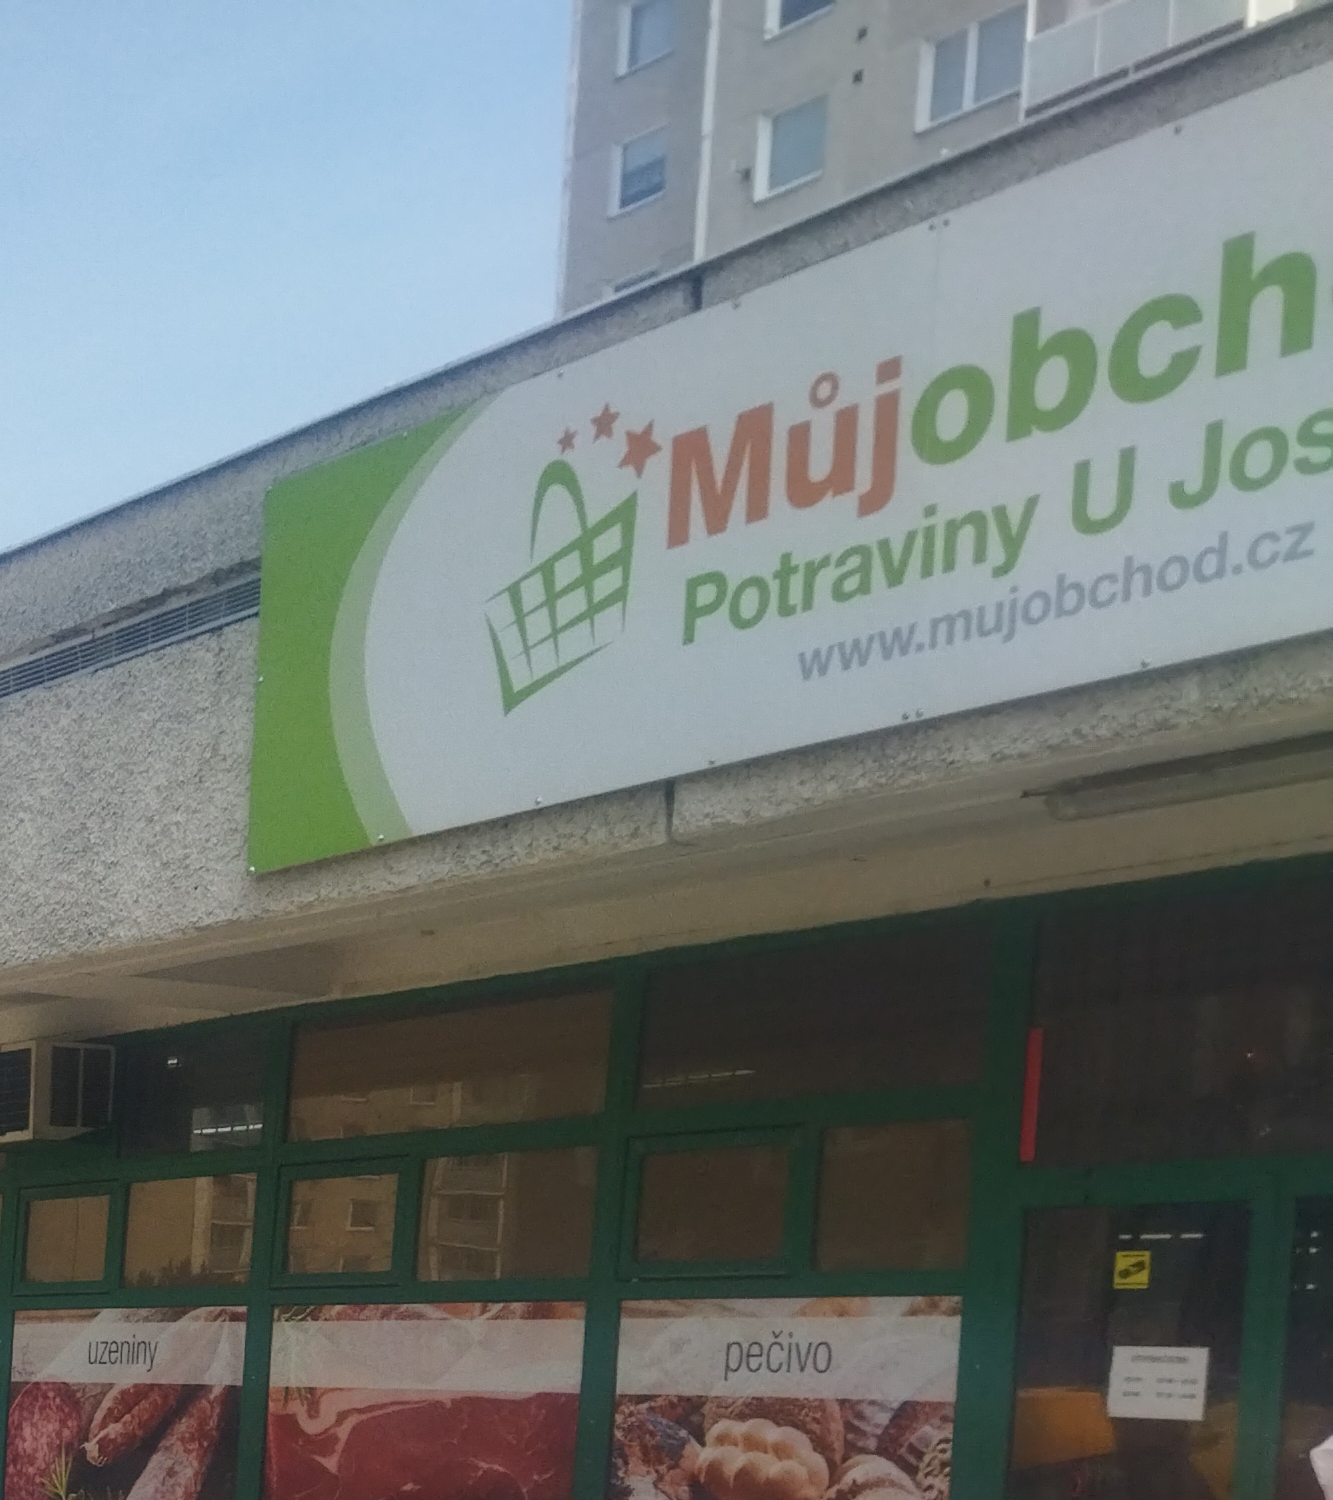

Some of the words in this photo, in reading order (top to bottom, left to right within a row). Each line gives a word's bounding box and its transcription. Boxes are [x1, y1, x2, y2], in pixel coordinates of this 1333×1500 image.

[665, 231, 1333, 551] Můjobch
[682, 495, 1040, 646] Potraviny
[1071, 446, 1137, 535] U
[797, 522, 1316, 681] www.mujobchod.cz
[87, 1334, 159, 1371] uzeniny
[724, 1330, 832, 1382] pečivo
